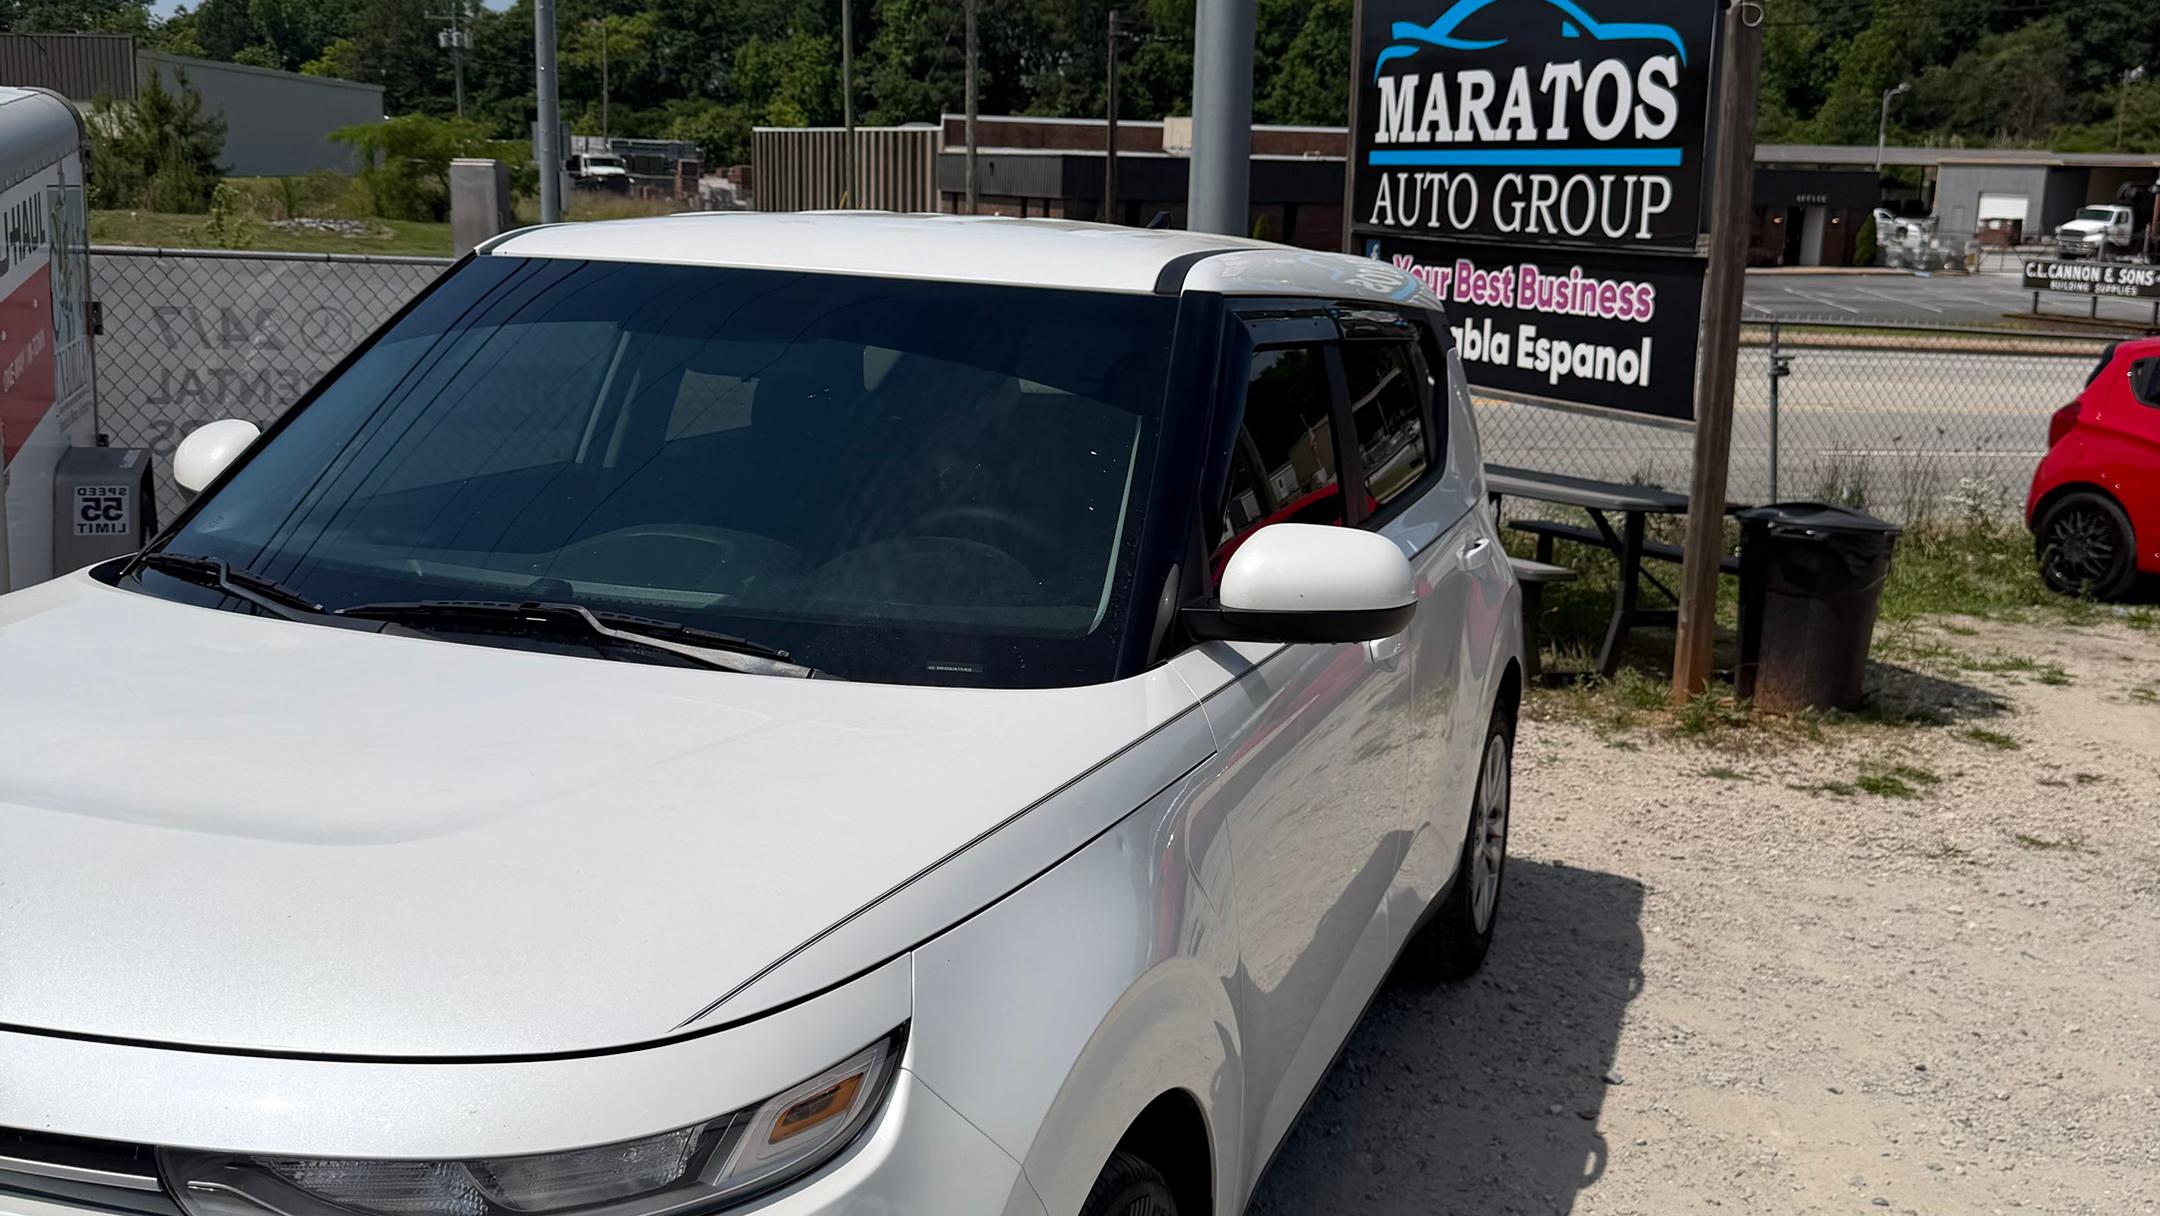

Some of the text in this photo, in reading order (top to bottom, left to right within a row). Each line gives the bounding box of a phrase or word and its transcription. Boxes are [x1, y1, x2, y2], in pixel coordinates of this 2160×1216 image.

[1374, 55, 1679, 143] MARATOS
[1369, 172, 1674, 240] AUTO GROUP
[1453, 258, 1515, 308] Best
[1517, 263, 1657, 323] Business
[2048, 264, 2100, 282] CANNON
[2104, 267, 2115, 283] &
[2117, 268, 2155, 286] SONS
[2049, 280, 2138, 296] BUILDING SUPPLIES
[1450, 317, 1652, 388] abla Espanol
